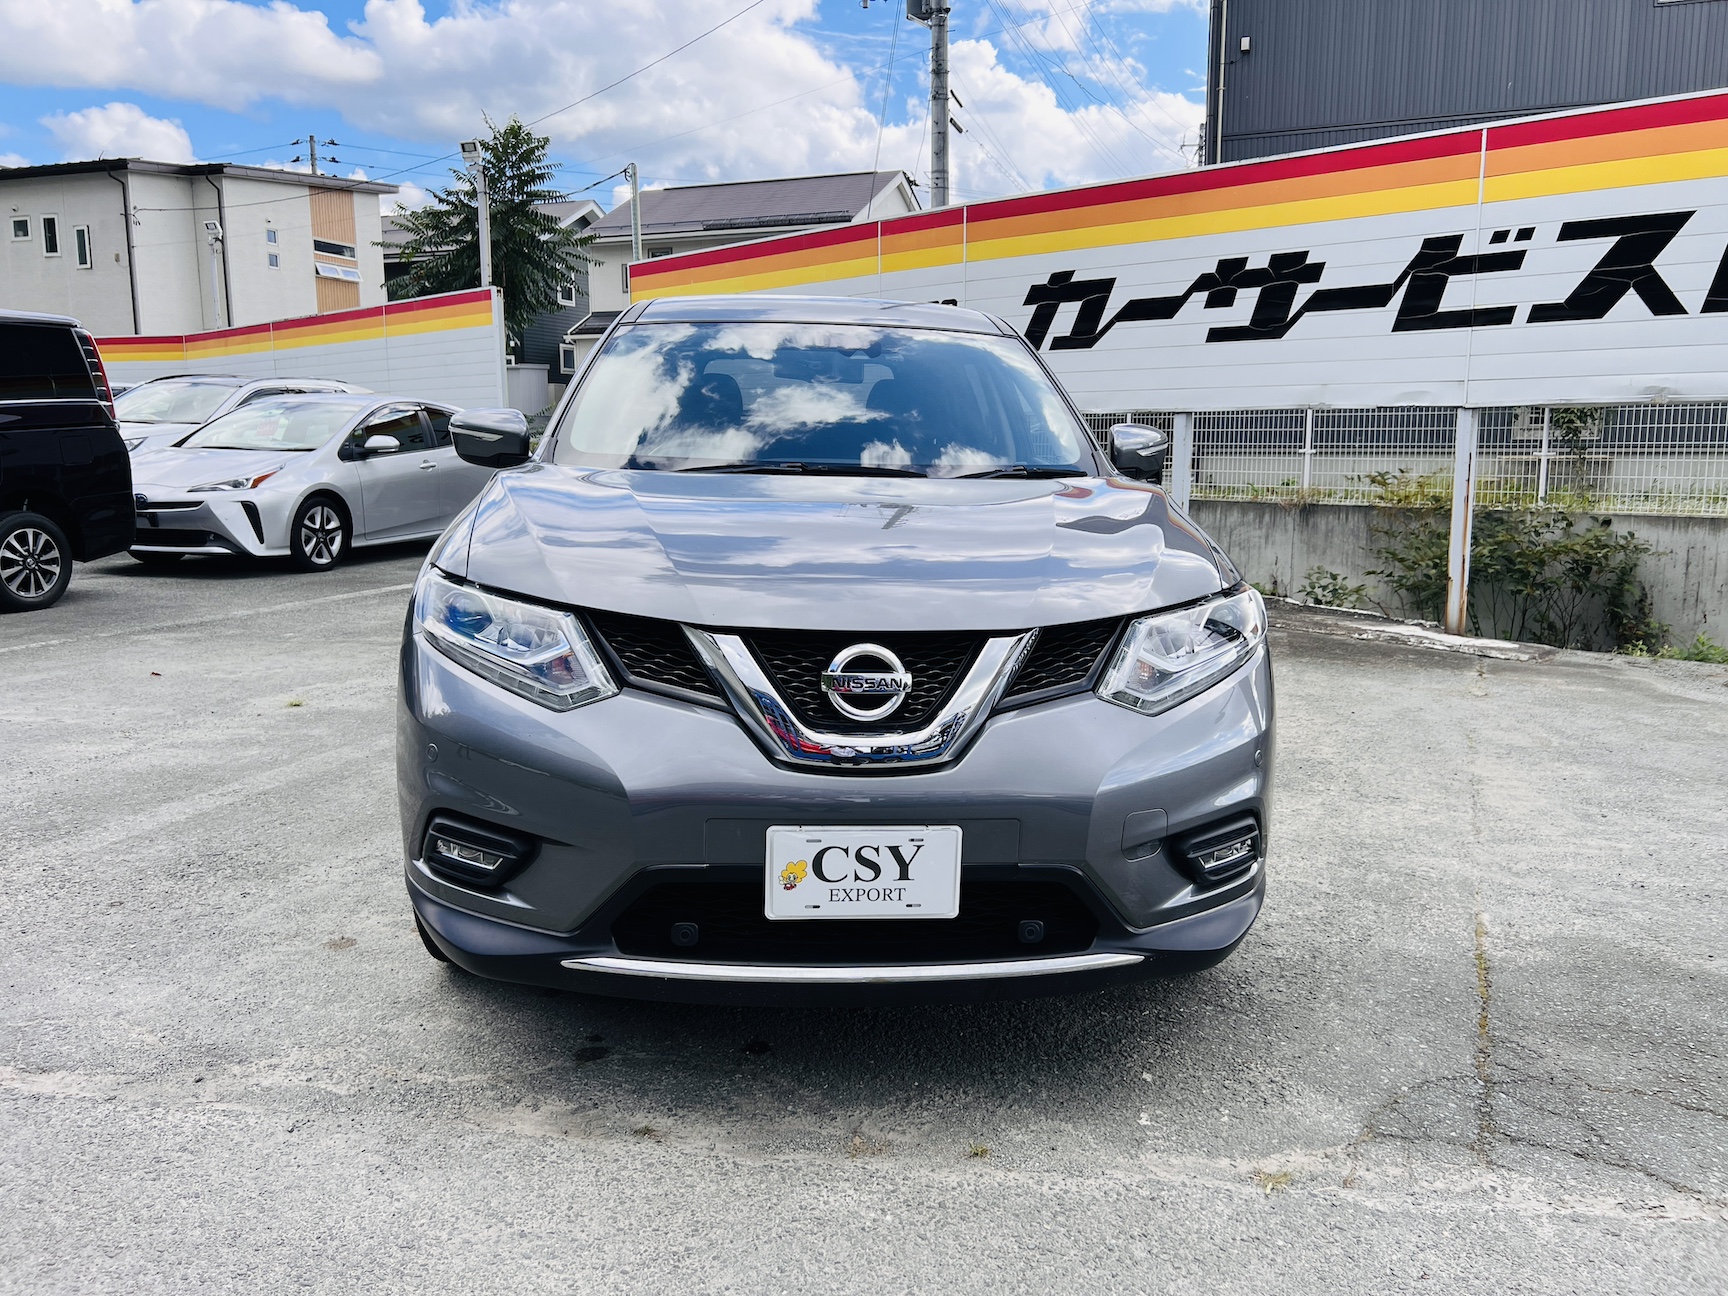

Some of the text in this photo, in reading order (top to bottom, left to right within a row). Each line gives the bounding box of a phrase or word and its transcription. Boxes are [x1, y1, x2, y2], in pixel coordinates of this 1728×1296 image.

[1023, 210, 1728, 350] カーサービス
[832, 677, 903, 689] NISSAN
[811, 844, 925, 883] CSY
[828, 887, 907, 902] EXPORT
